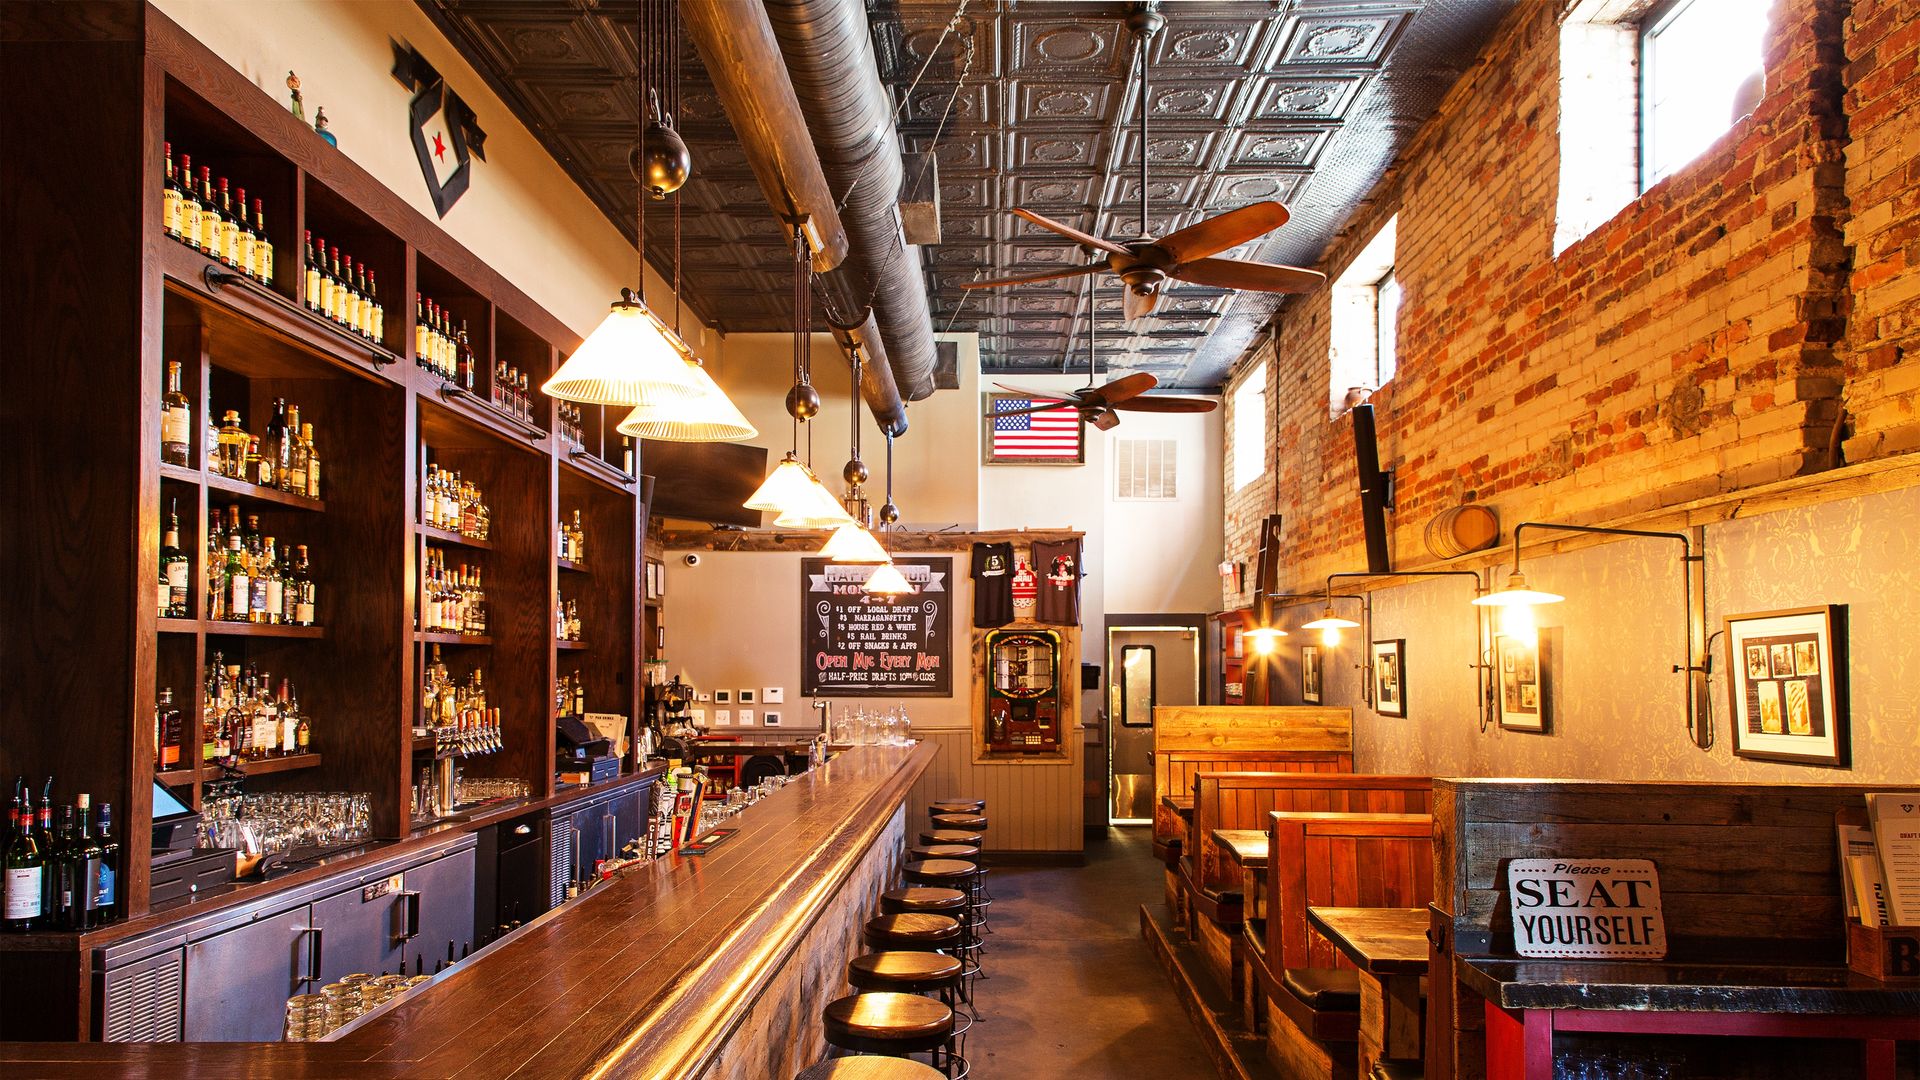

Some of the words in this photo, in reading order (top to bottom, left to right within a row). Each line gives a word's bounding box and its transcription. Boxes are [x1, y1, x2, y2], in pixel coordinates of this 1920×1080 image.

[991, 555, 999, 566] 5
[860, 595, 870, 604] 4
[887, 595, 897, 604] 7
[839, 614, 848, 622] $3
[854, 614, 912, 622] NARRAGANSETTS
[848, 623, 870, 631] HOUSE
[871, 623, 885, 631] RED
[887, 623, 893, 631] &
[895, 623, 917, 631] WHITE
[860, 632, 876, 640] RAIL
[881, 632, 907, 640] DRINKS
[838, 642, 846, 650] $2
[848, 642, 861, 650] OFF
[864, 642, 890, 650] SNACKS
[892, 642, 898, 650] &
[900, 642, 918, 650] APPS
[828, 672, 868, 681] HALF-PRICE
[871, 672, 897, 681] DRAFTS
[919, 672, 936, 681] CLOSE
[1552, 863, 1611, 875] Please
[1516, 879, 1652, 908] SEAT
[1519, 915, 1655, 945] YOURSELF
